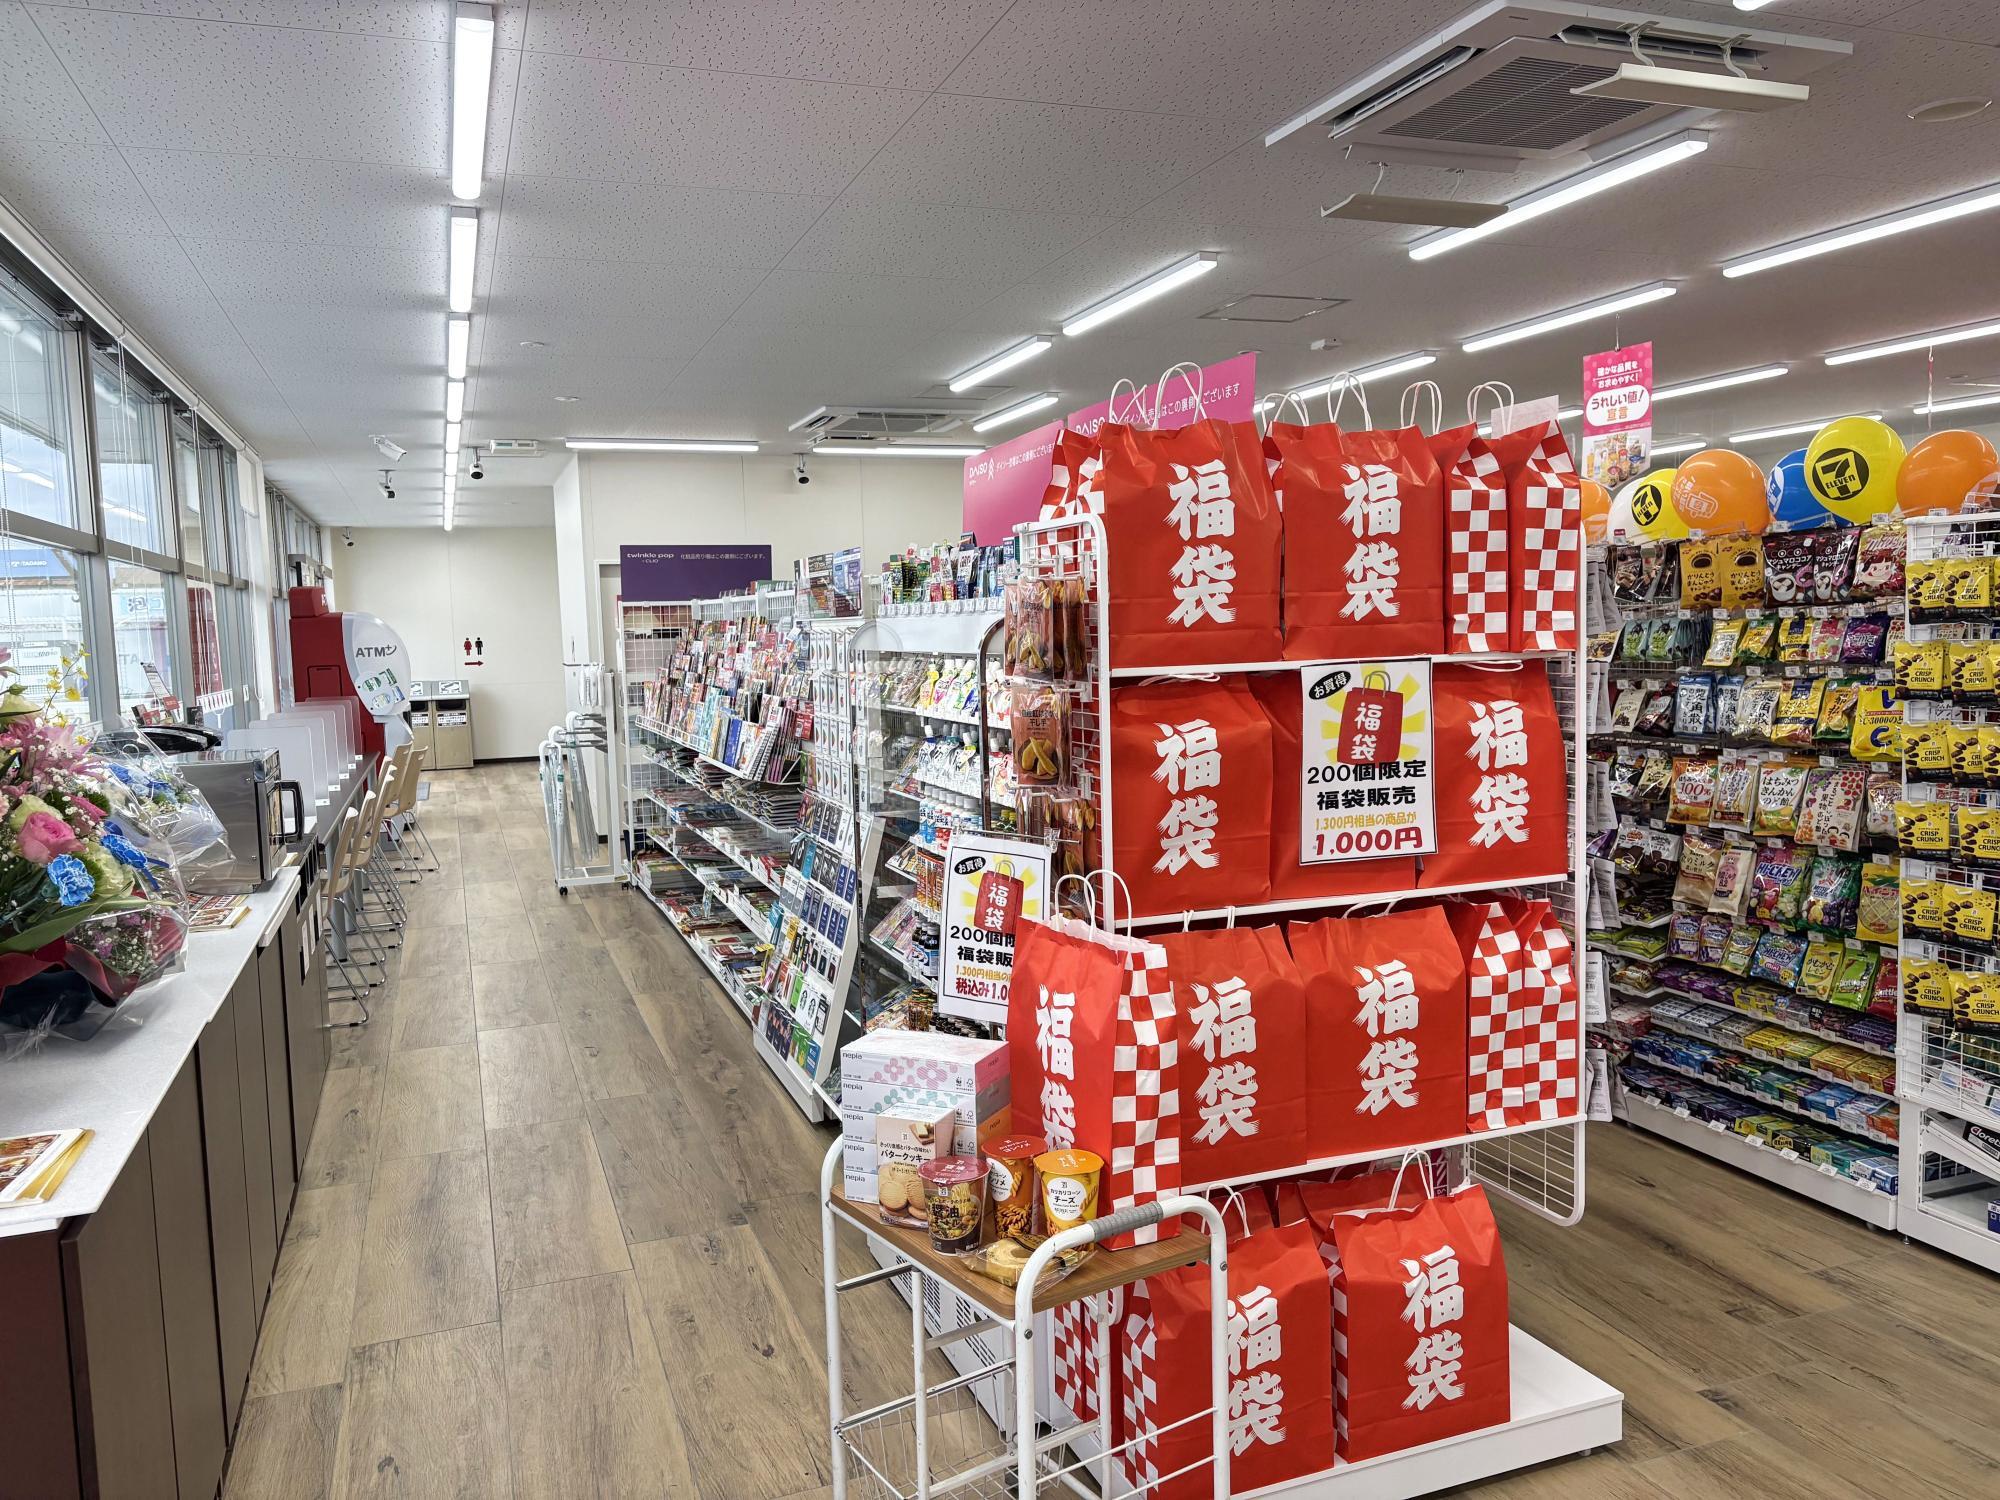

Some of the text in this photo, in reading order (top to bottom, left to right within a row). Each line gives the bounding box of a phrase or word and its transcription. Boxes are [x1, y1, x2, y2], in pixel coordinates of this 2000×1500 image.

[969, 462, 988, 479] DAISO
[1166, 459, 1236, 628] 福袋
[1338, 464, 1403, 622] 福袋
[355, 647, 386, 658] ATM
[1314, 673, 1347, 698] お買得
[1351, 702, 1384, 761] 福袋
[1307, 760, 1427, 784] 200個限定
[1465, 701, 1531, 849] 福袋
[1762, 776, 1799, 787] はちみつ
[1681, 783, 1711, 796] 100%
[1760, 787, 1795, 796] きんかん
[1152, 721, 1221, 876] 福袋
[1317, 786, 1416, 810] 福袋販売
[1316, 827, 1423, 855] 1,000円
[957, 859, 984, 874] お買得
[984, 883, 1009, 931] 福袋
[1959, 923, 1986, 933] CRUNCH
[1920, 994, 1945, 1002] CRUNCH
[1972, 1008, 1999, 1016] CRUNCH
[1352, 960, 1420, 1116] 福袋
[842, 1051, 862, 1060] nepia
[1188, 977, 1259, 1146] 福袋
[843, 1083, 863, 1091] nepia
[843, 1113, 864, 1121] nepia
[844, 1144, 865, 1152] nepia
[881, 1150, 930, 1162] バタークッキー
[845, 1174, 866, 1183] nepia
[1051, 1188, 1080, 1196] カリカリコーン
[1055, 1196, 1076, 1204] チーズ
[1402, 1245, 1465, 1411] 福袋
